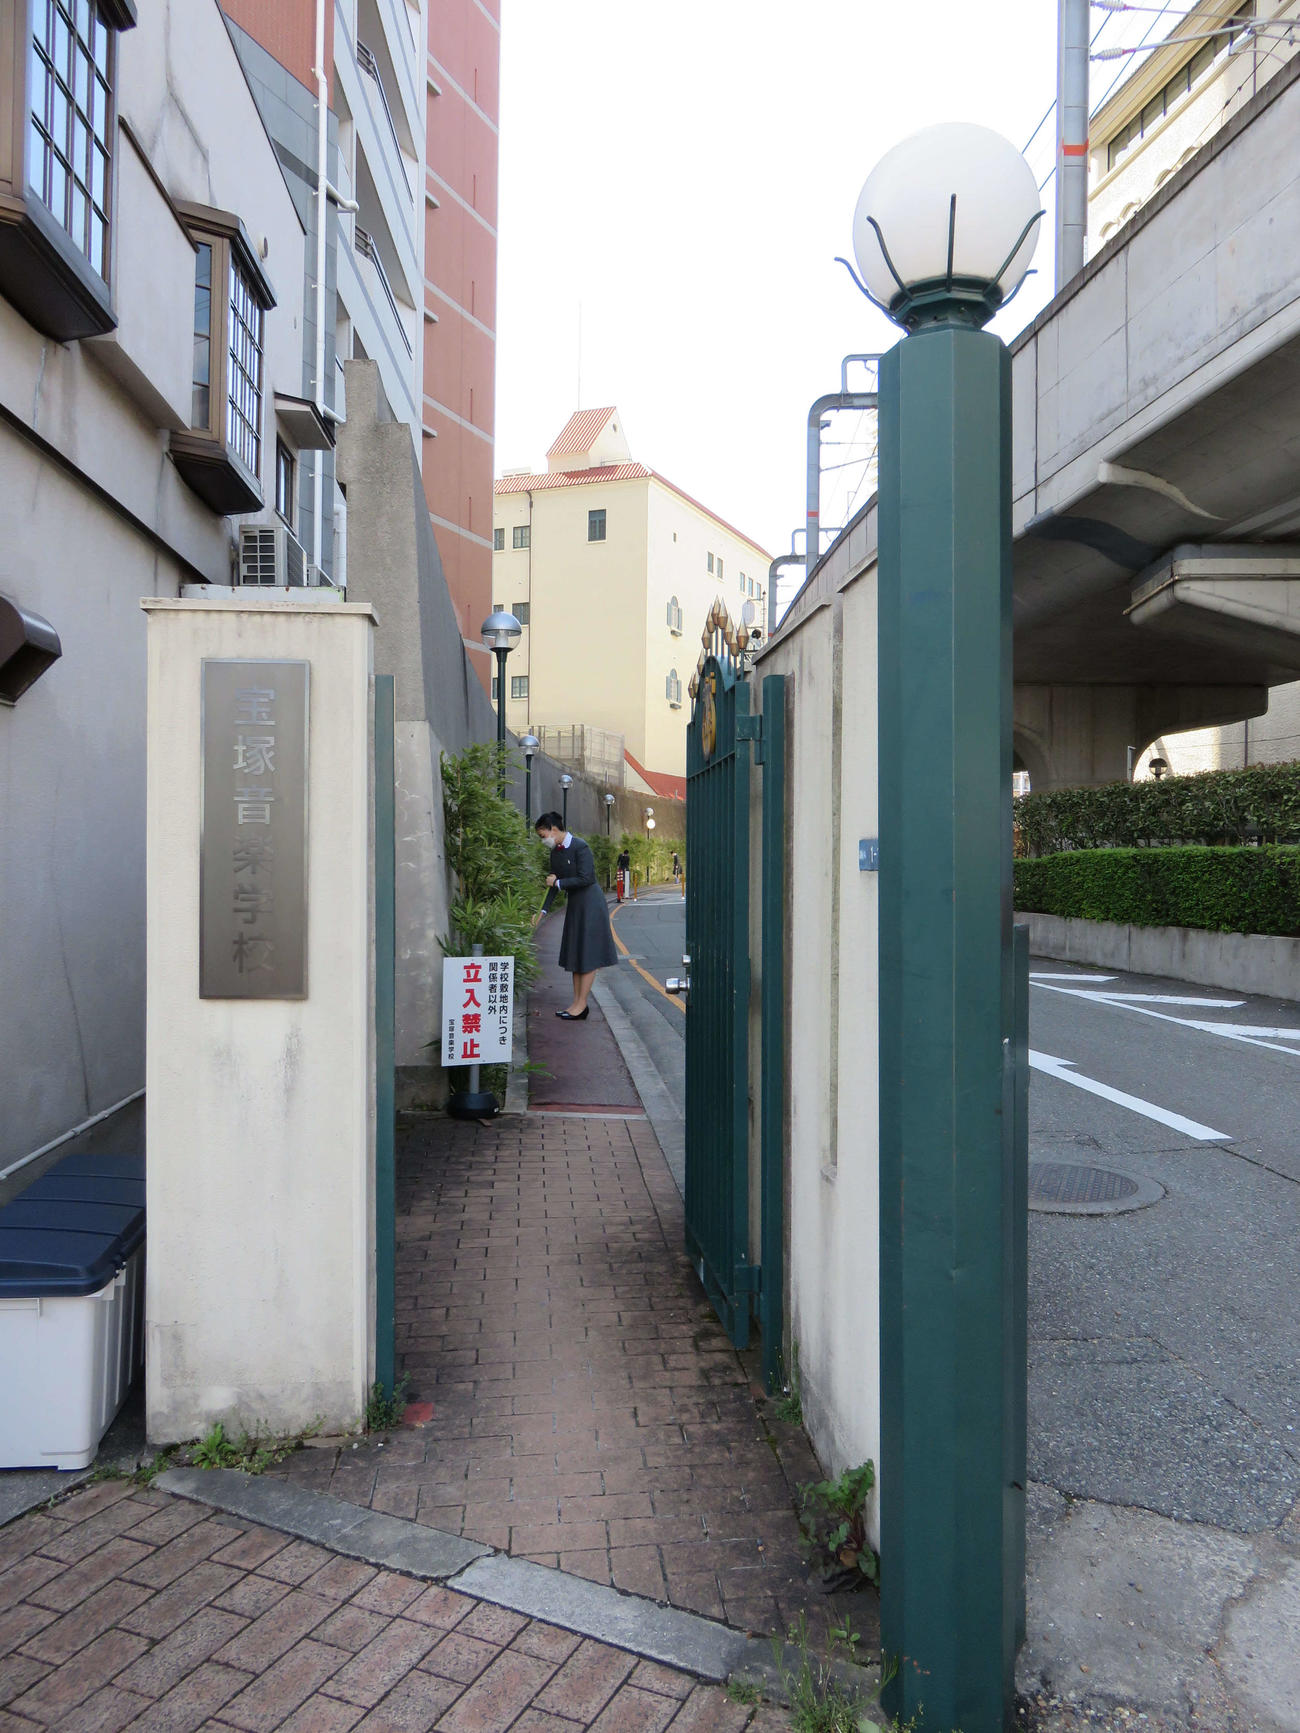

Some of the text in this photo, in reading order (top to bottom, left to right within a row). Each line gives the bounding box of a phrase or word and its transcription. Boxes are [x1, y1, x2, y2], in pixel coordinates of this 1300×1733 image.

[232, 687, 277, 973] 宝塚音楽学校
[461, 962, 482, 1059] 立入禁止
[488, 962, 498, 1015] 関係者以外
[498, 962, 509, 1045] 学校敷地内につき
